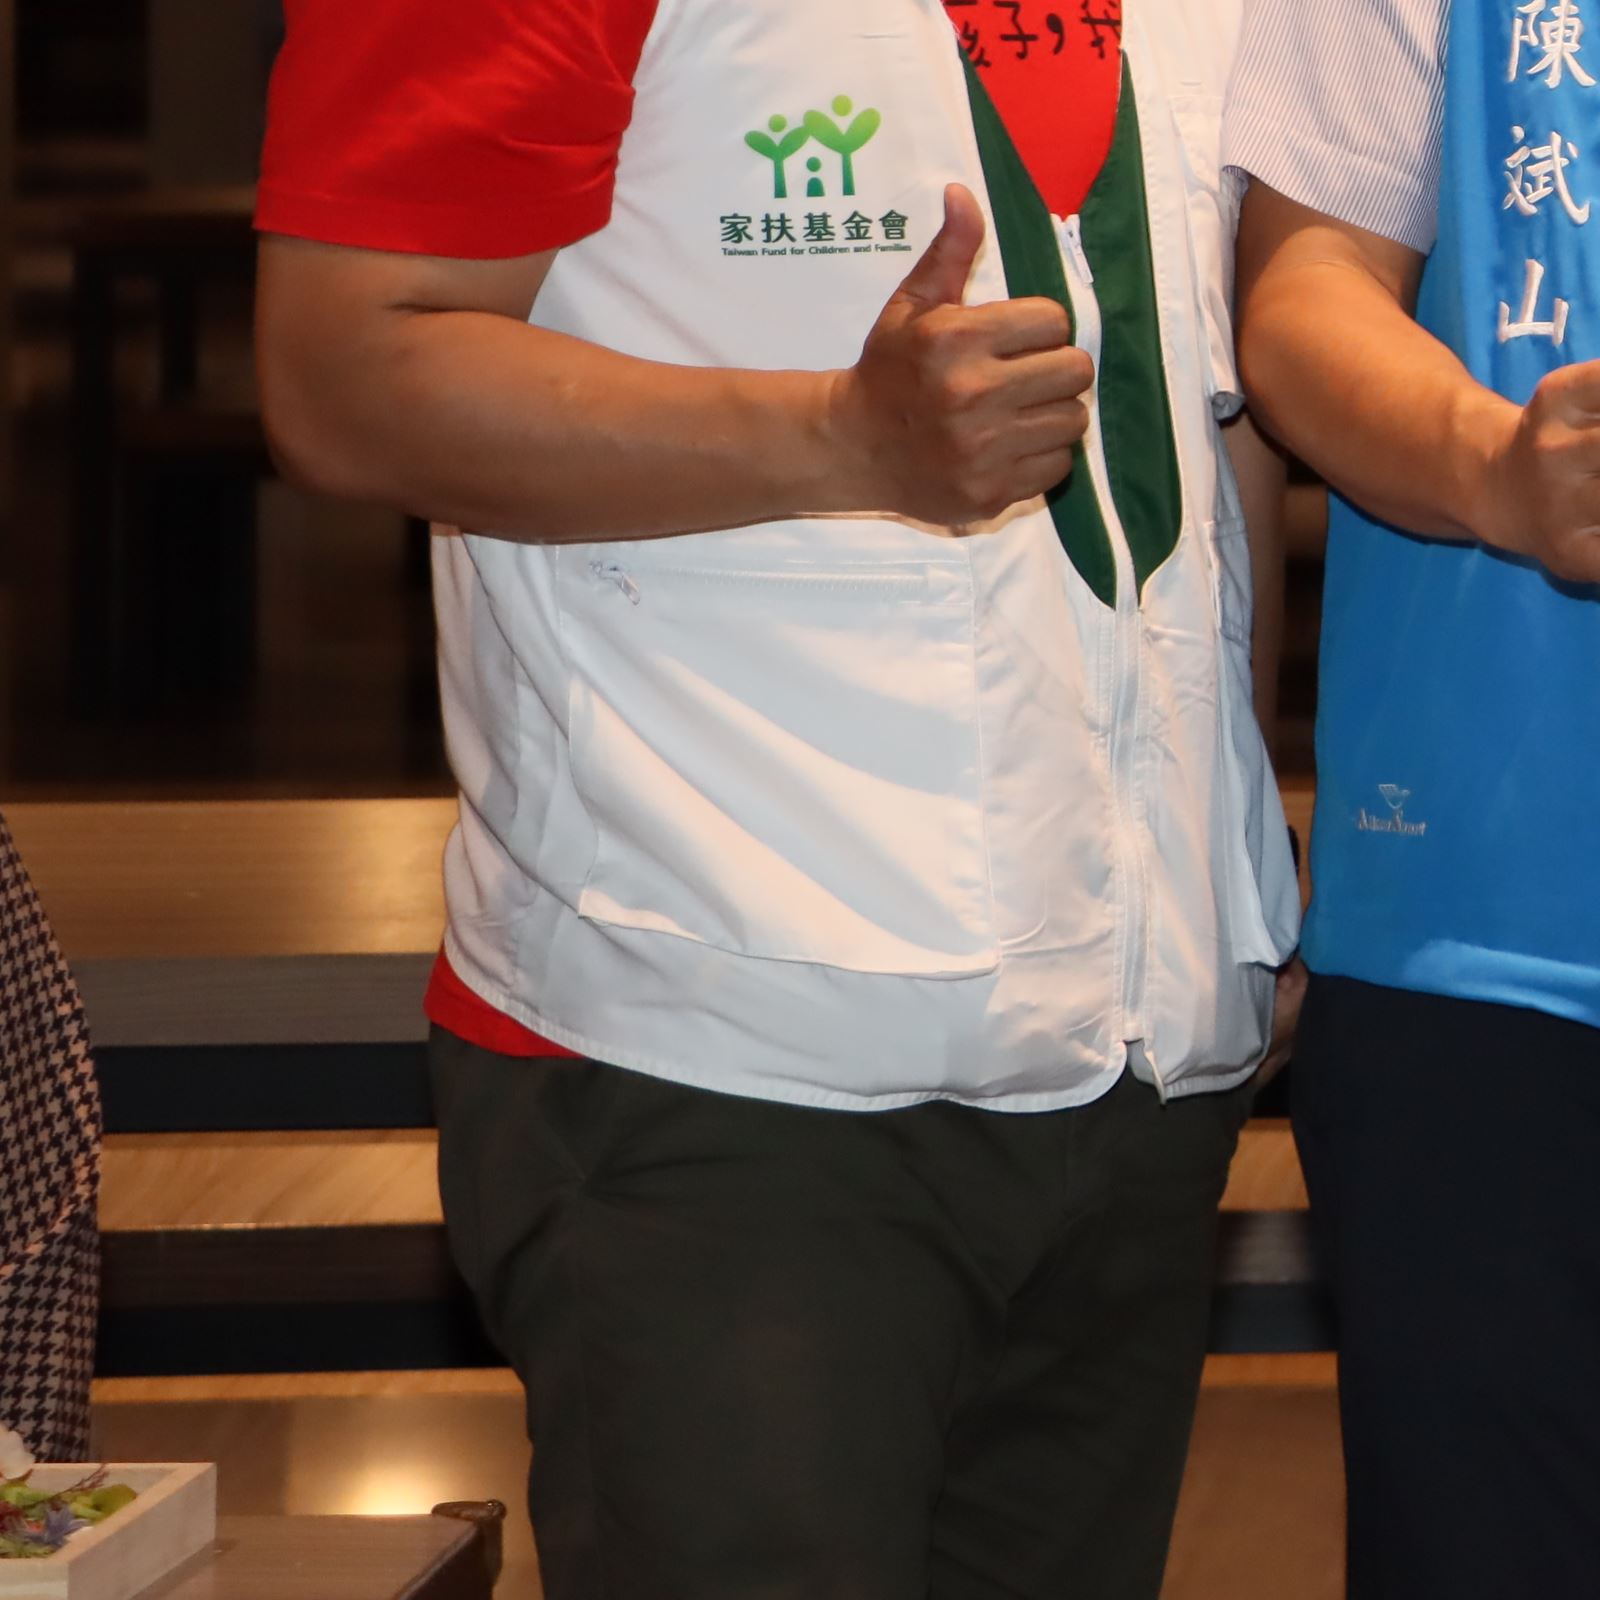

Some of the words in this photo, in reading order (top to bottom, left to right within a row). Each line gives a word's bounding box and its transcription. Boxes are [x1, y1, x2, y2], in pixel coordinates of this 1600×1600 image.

[719, 209, 909, 243] 家扶基金會
[721, 247, 758, 256] Taiwan
[761, 247, 787, 256] Fund
[790, 246, 805, 255] for
[808, 245, 850, 255] Children
[853, 244, 872, 253] and
[875, 243, 912, 252] Families
